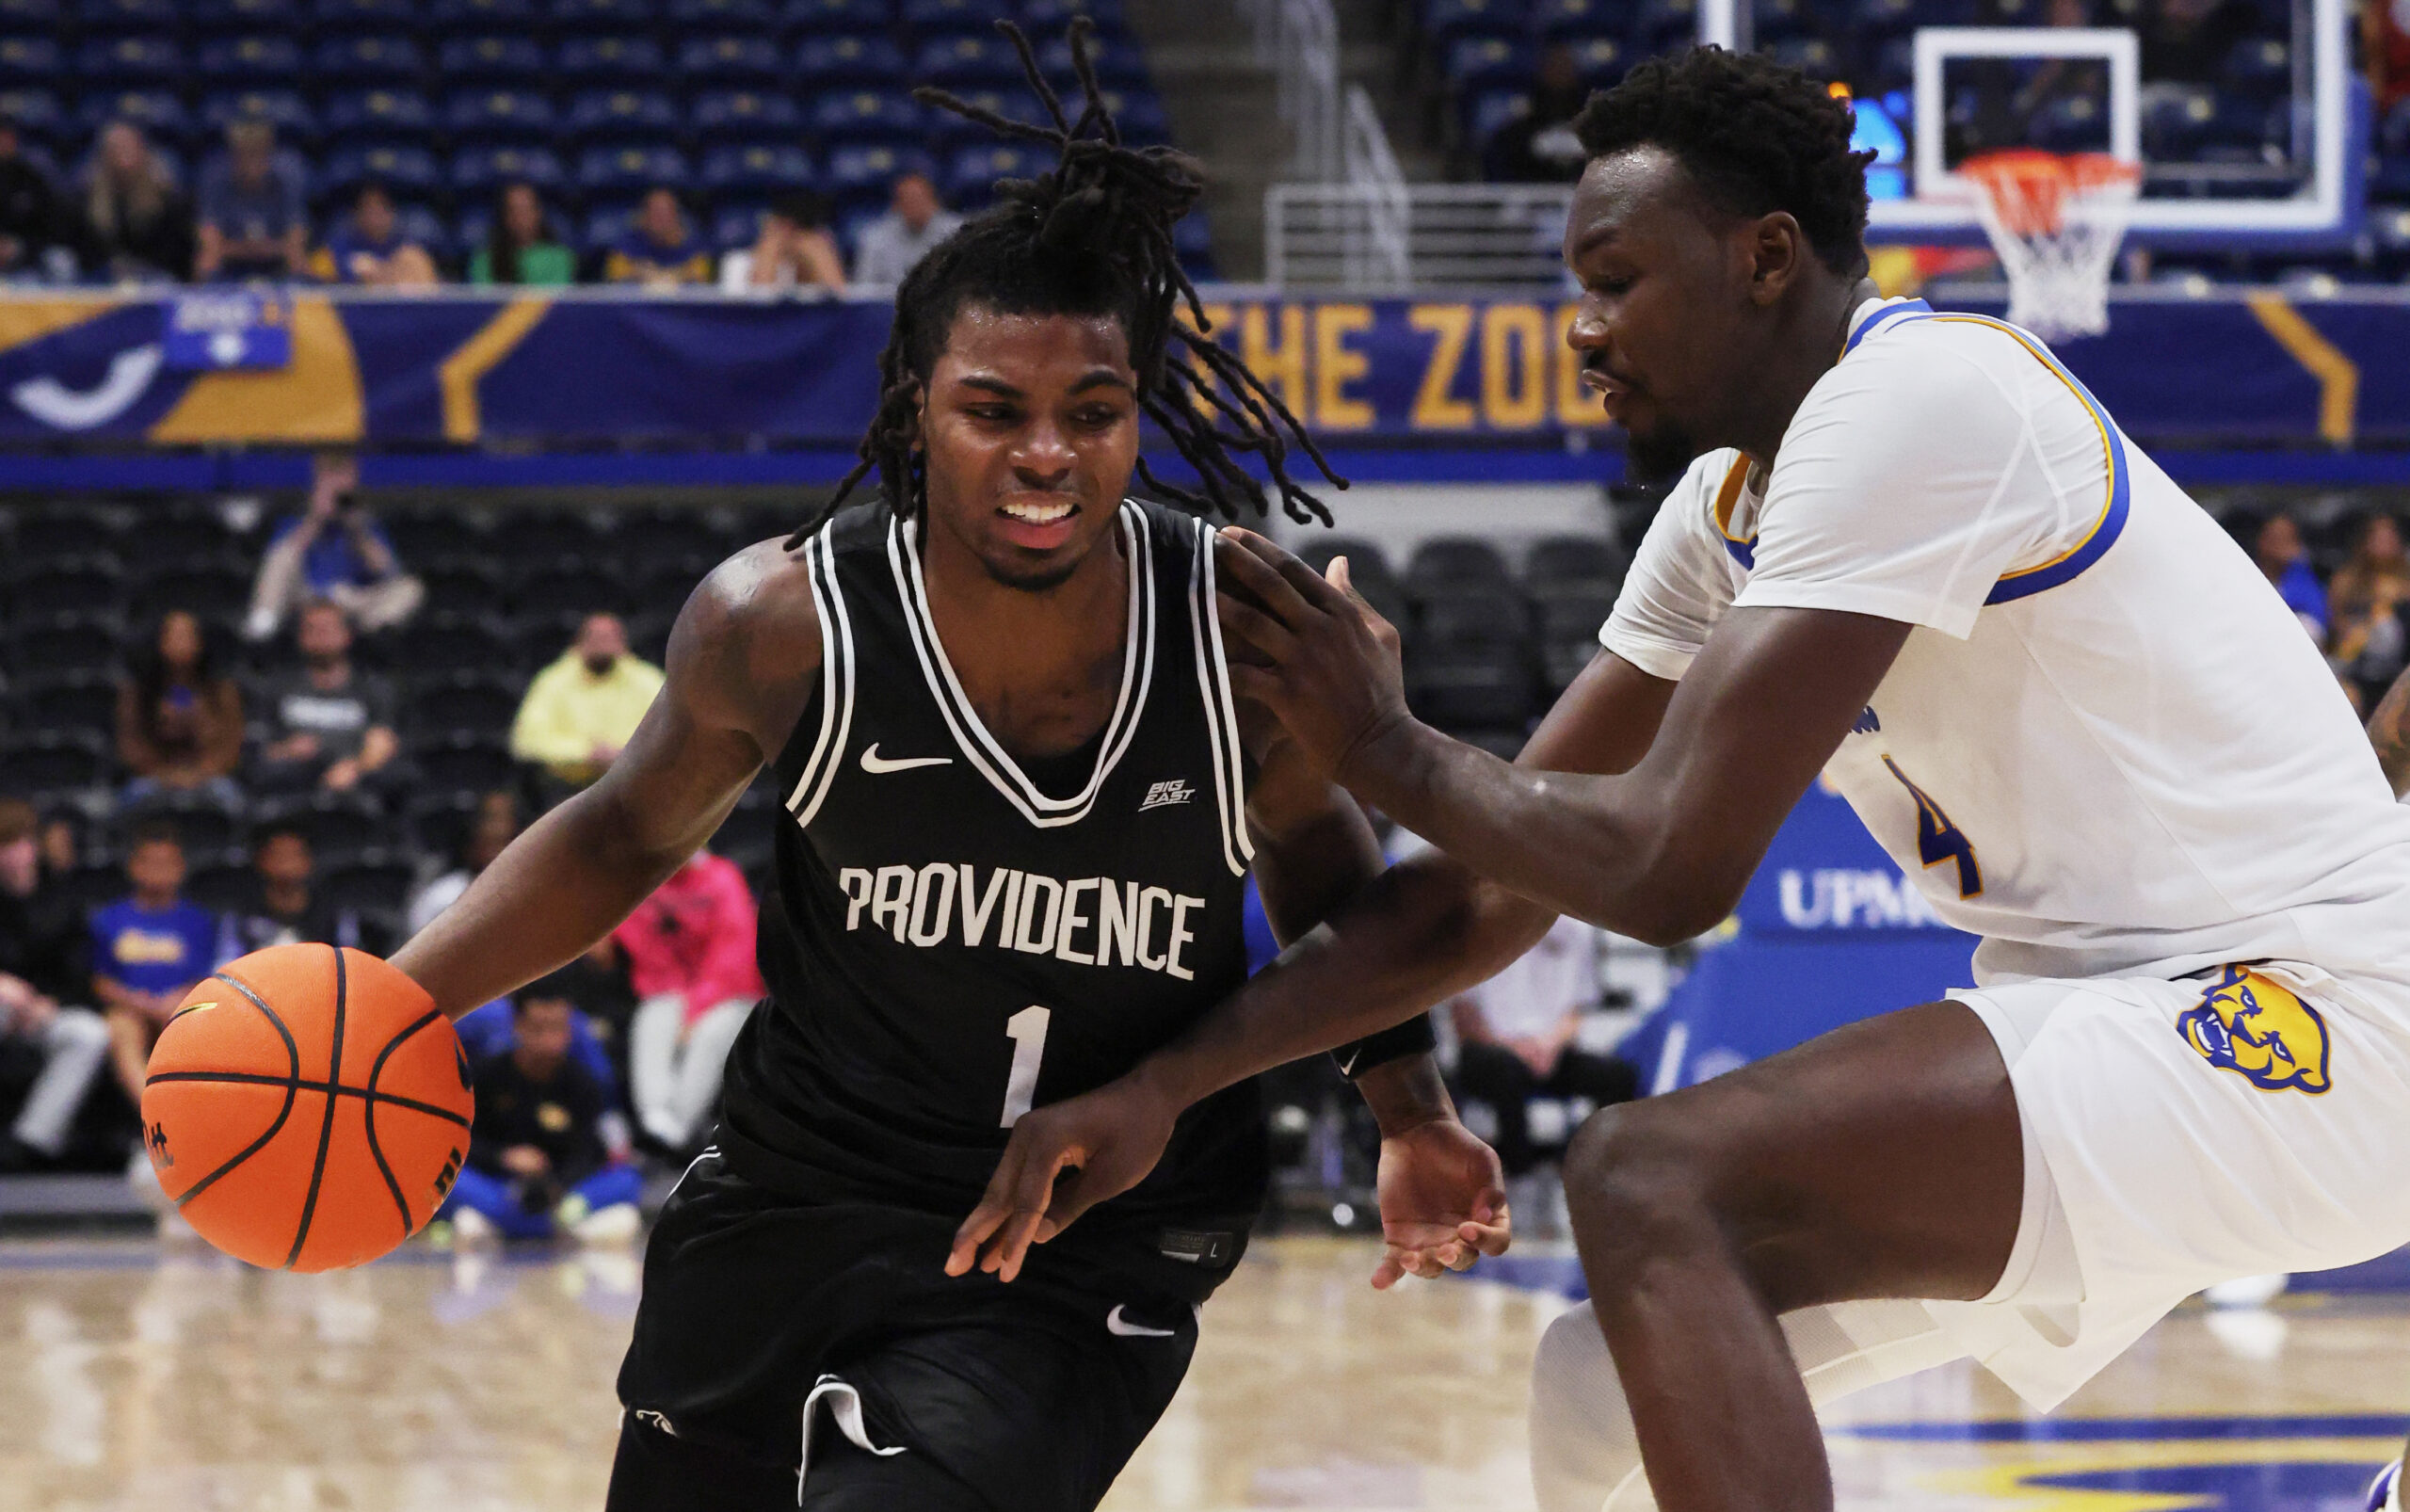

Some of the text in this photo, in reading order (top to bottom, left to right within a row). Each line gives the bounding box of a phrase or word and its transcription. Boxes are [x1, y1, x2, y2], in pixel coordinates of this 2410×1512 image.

[1173, 303, 1376, 430] THE
[1142, 789, 1196, 806] EAST
[1148, 780, 1185, 795] BIG
[1881, 754, 1984, 901] 4
[839, 862, 1206, 981] PROVIDENCE
[1779, 867, 1947, 929] UPM
[999, 1005, 1051, 1129] 1
